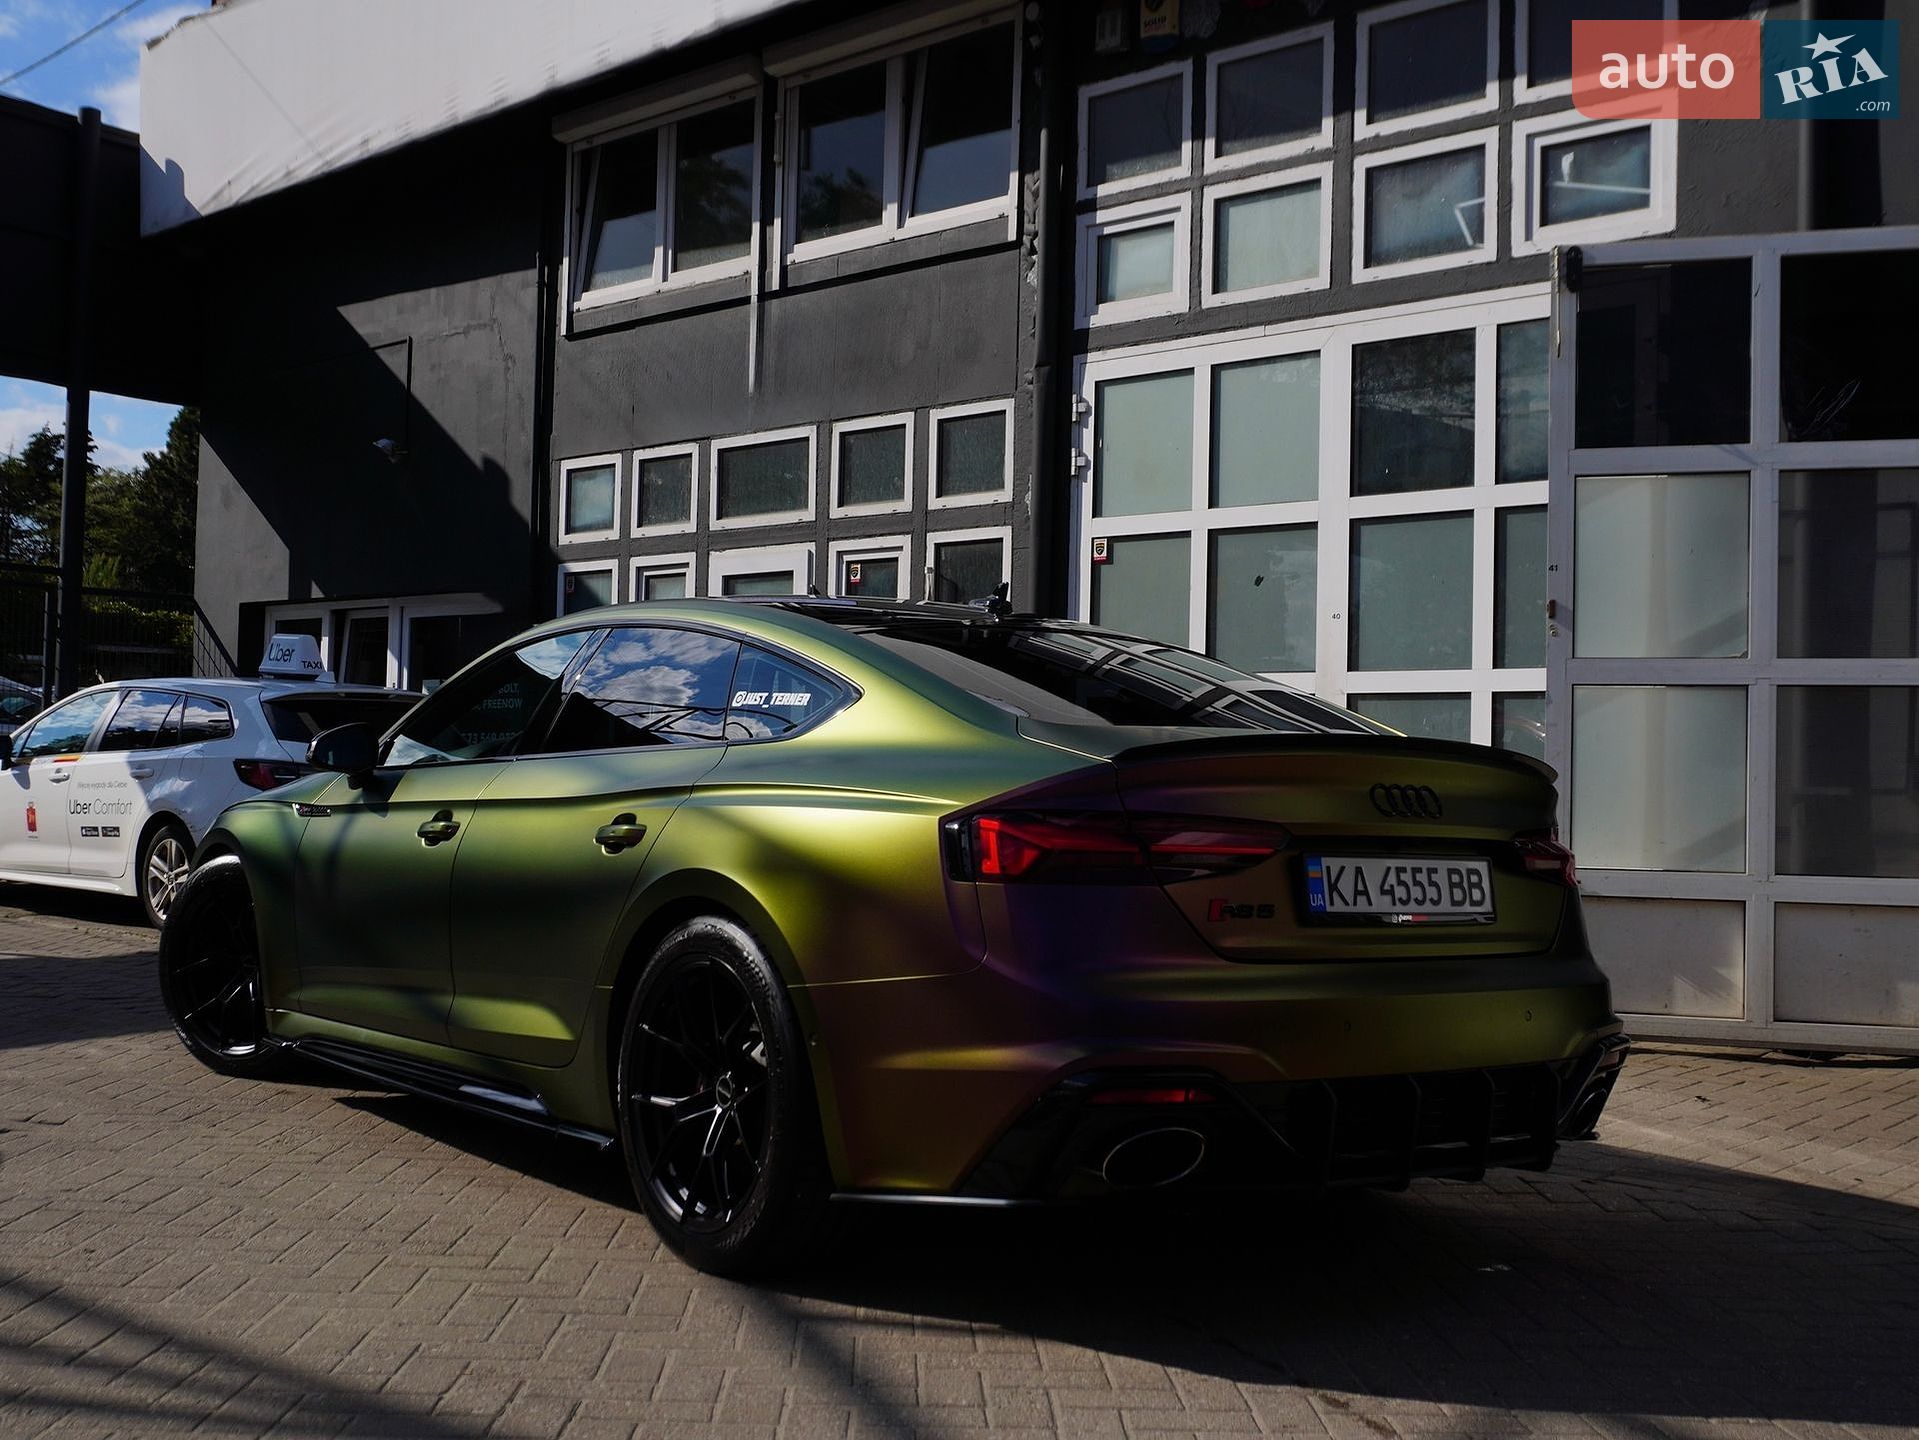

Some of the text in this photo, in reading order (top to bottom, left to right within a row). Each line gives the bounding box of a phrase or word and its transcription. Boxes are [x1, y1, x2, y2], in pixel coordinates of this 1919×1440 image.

[268, 642, 295, 663] Uber
[301, 660, 322, 670] TAXI
[69, 798, 132, 815] Uber Comfort
[1325, 866, 1486, 907] KA 4555 BB
[1310, 893, 1324, 907] UA
